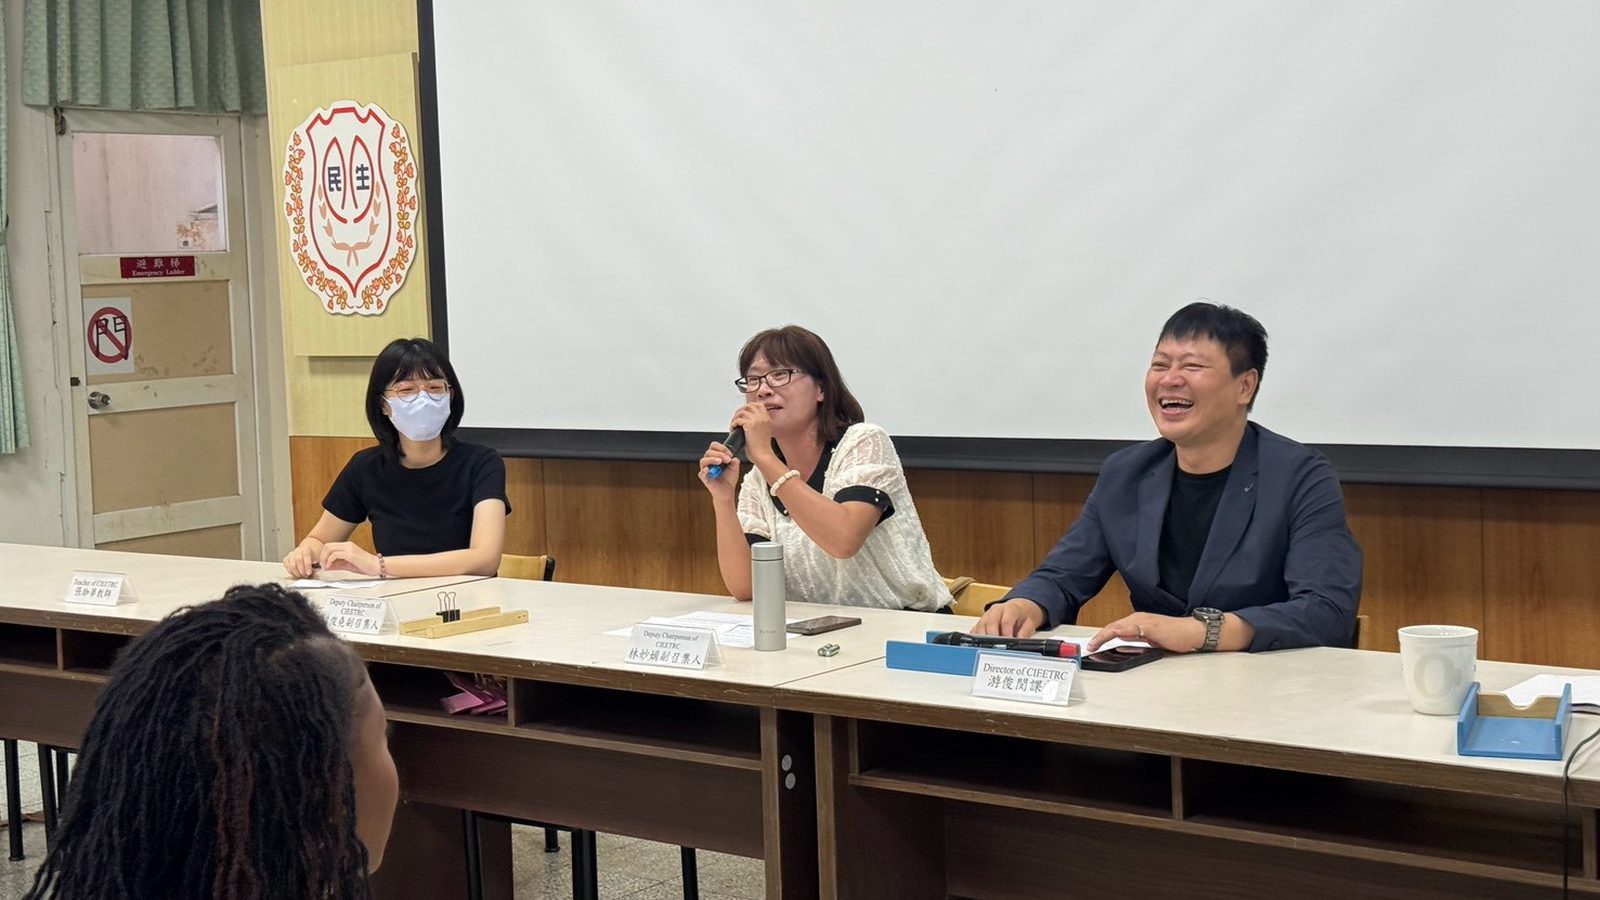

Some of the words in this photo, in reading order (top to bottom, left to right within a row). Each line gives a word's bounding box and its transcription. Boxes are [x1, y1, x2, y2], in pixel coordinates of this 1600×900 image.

[136, 257, 180, 270] 避難梯
[329, 598, 346, 607] Deputy
[347, 600, 375, 609] Chairperson
[643, 630, 660, 639] Deputy
[662, 632, 692, 641] Chairperson
[983, 663, 1015, 675] Director
[1015, 666, 1027, 676] of
[1026, 667, 1068, 681] CIEETRC
